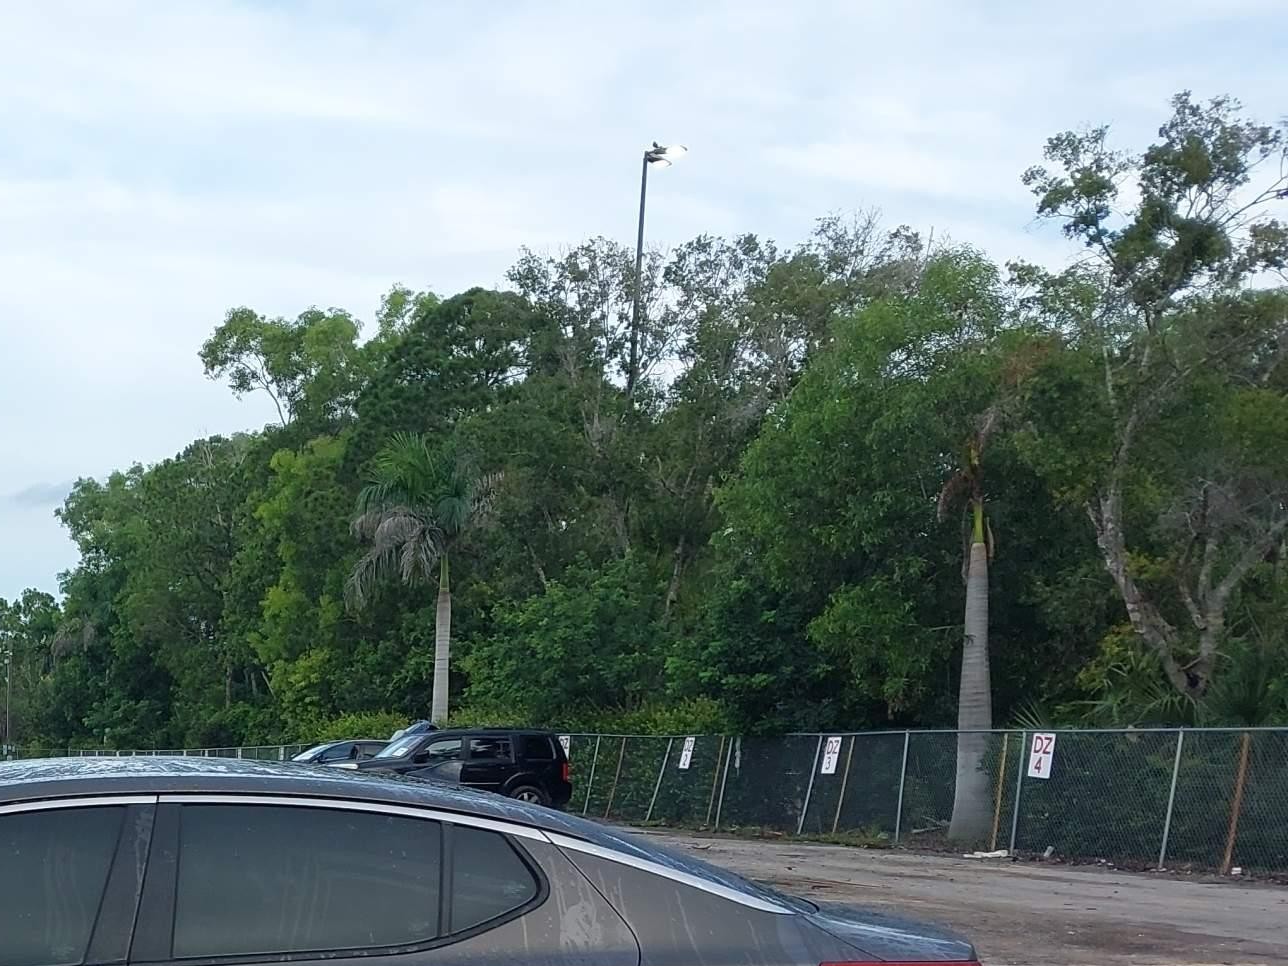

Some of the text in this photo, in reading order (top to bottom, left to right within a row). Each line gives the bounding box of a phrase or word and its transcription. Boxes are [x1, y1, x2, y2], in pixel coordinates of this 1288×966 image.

[826, 739, 840, 755] DZ
[1033, 735, 1053, 754] DZ
[825, 756, 832, 770] 3
[1034, 755, 1043, 774] 4
